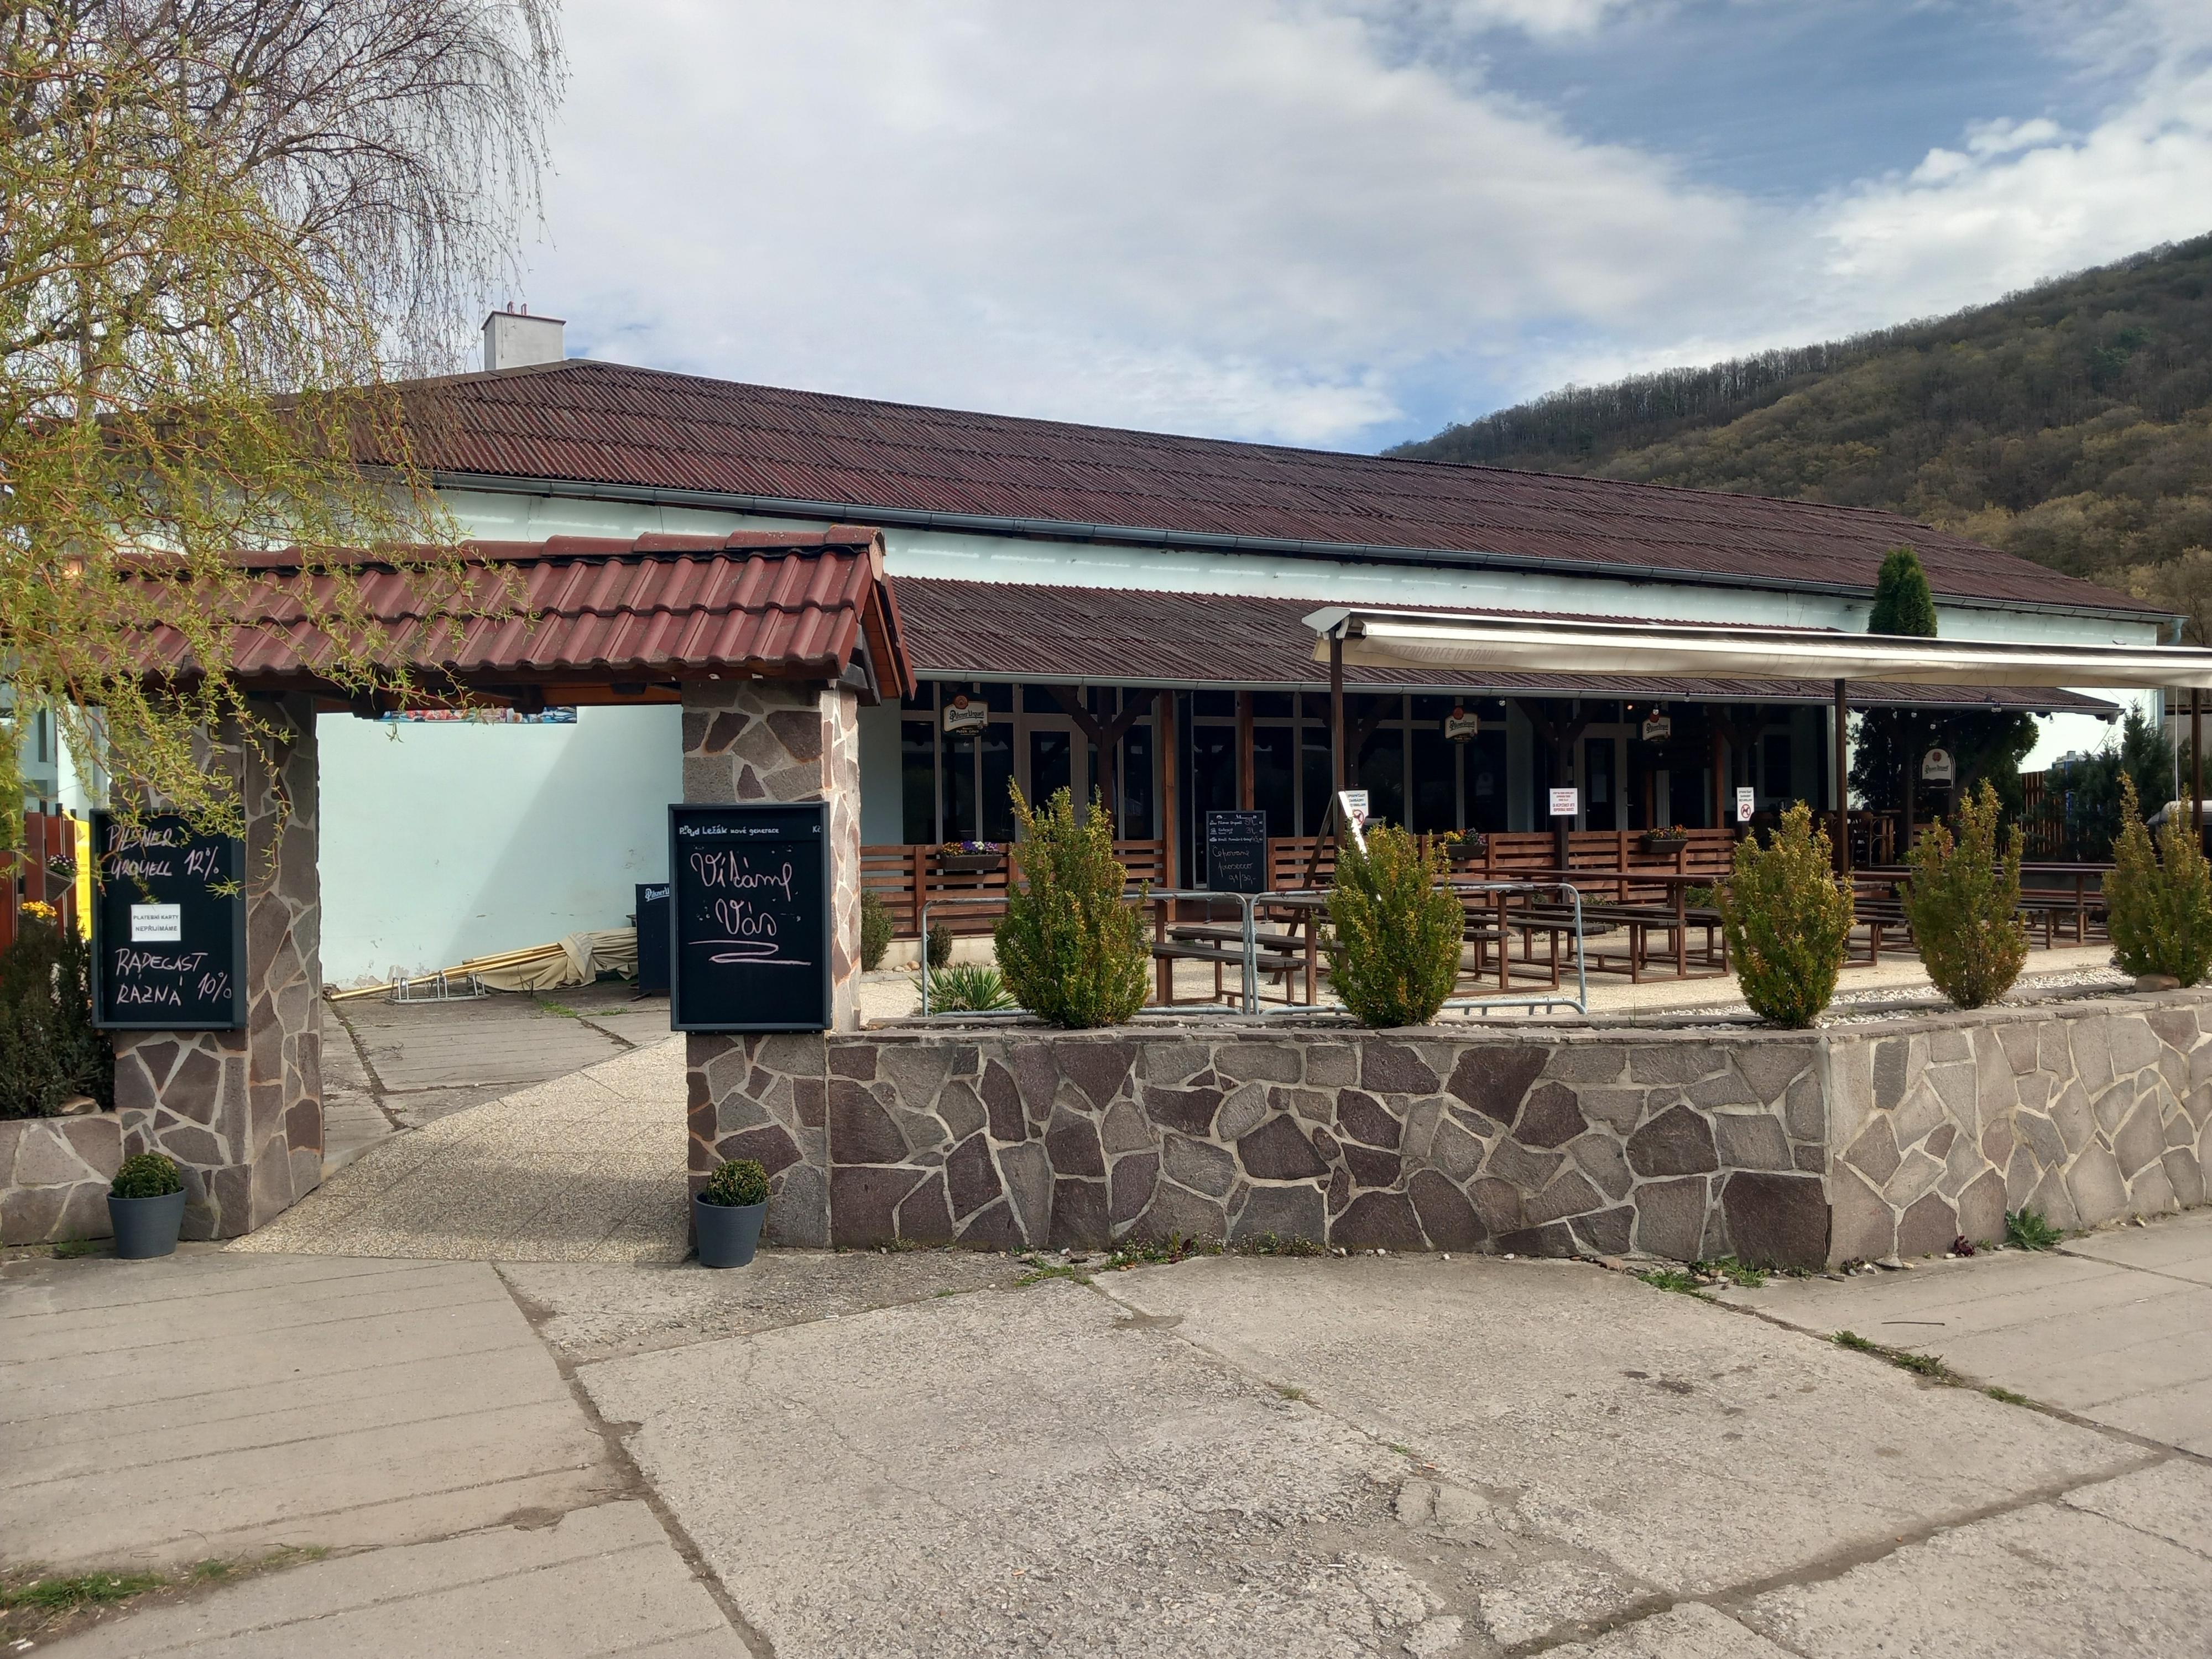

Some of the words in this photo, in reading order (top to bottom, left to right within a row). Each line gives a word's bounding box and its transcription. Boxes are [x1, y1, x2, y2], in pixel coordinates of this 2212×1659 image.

[1454, 648, 1464, 660] U
[106, 825, 177, 852] PILSNER
[702, 824, 728, 834] Ležák
[749, 827, 779, 836] generace
[812, 825, 822, 833] Kč
[111, 858, 173, 881] URQUELL
[184, 846, 220, 881] 12%
[714, 898, 777, 936] Vás
[115, 948, 208, 977] RADEGAST
[198, 970, 232, 1003] 10%
